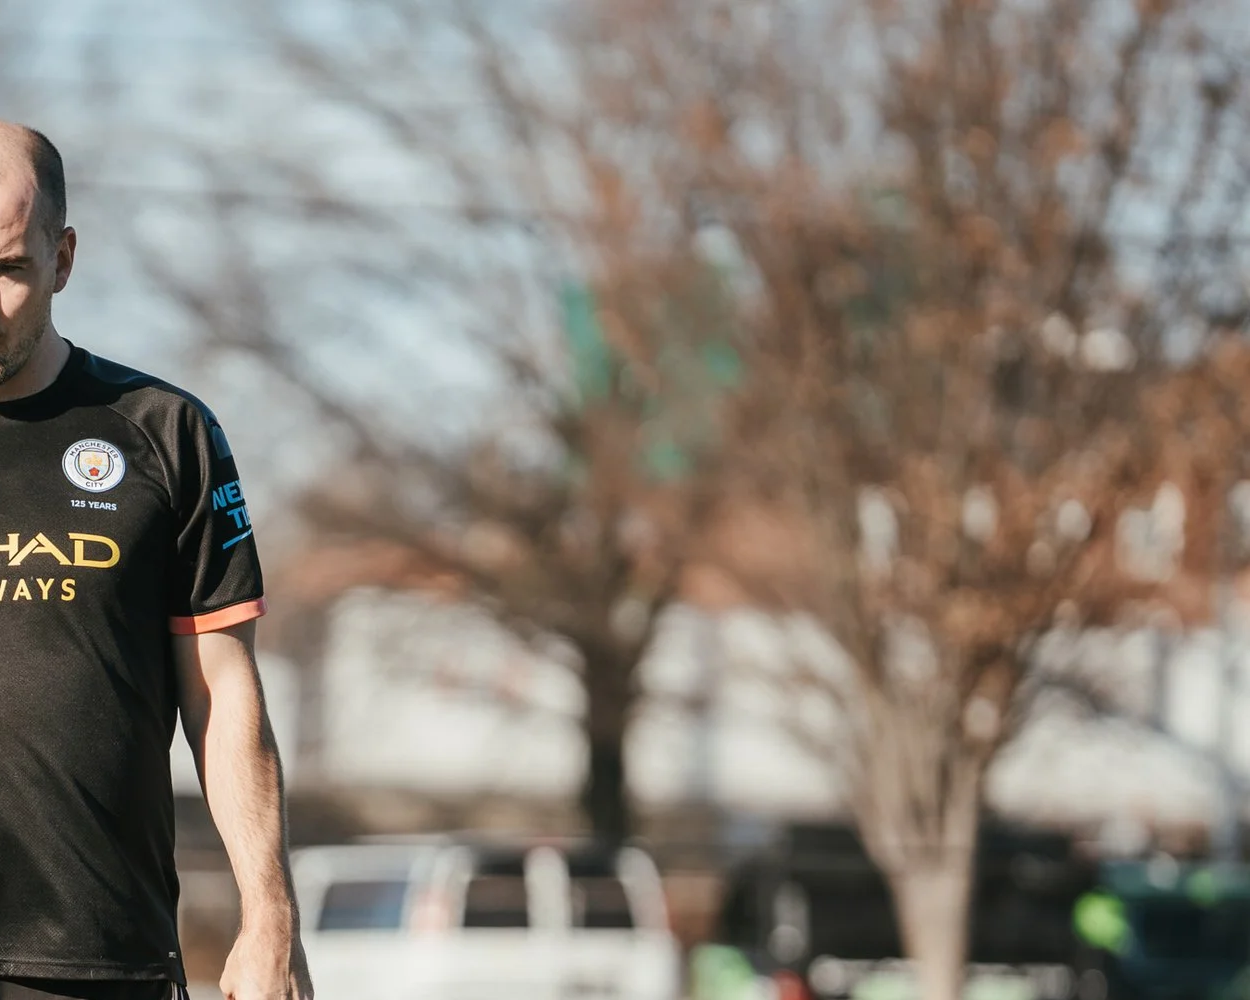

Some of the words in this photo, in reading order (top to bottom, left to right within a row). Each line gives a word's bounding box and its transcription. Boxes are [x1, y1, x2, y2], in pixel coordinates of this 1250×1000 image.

[70, 442, 119, 459] MANCHESTER
[70, 500, 86, 508] 125
[88, 501, 117, 511] YEARS
